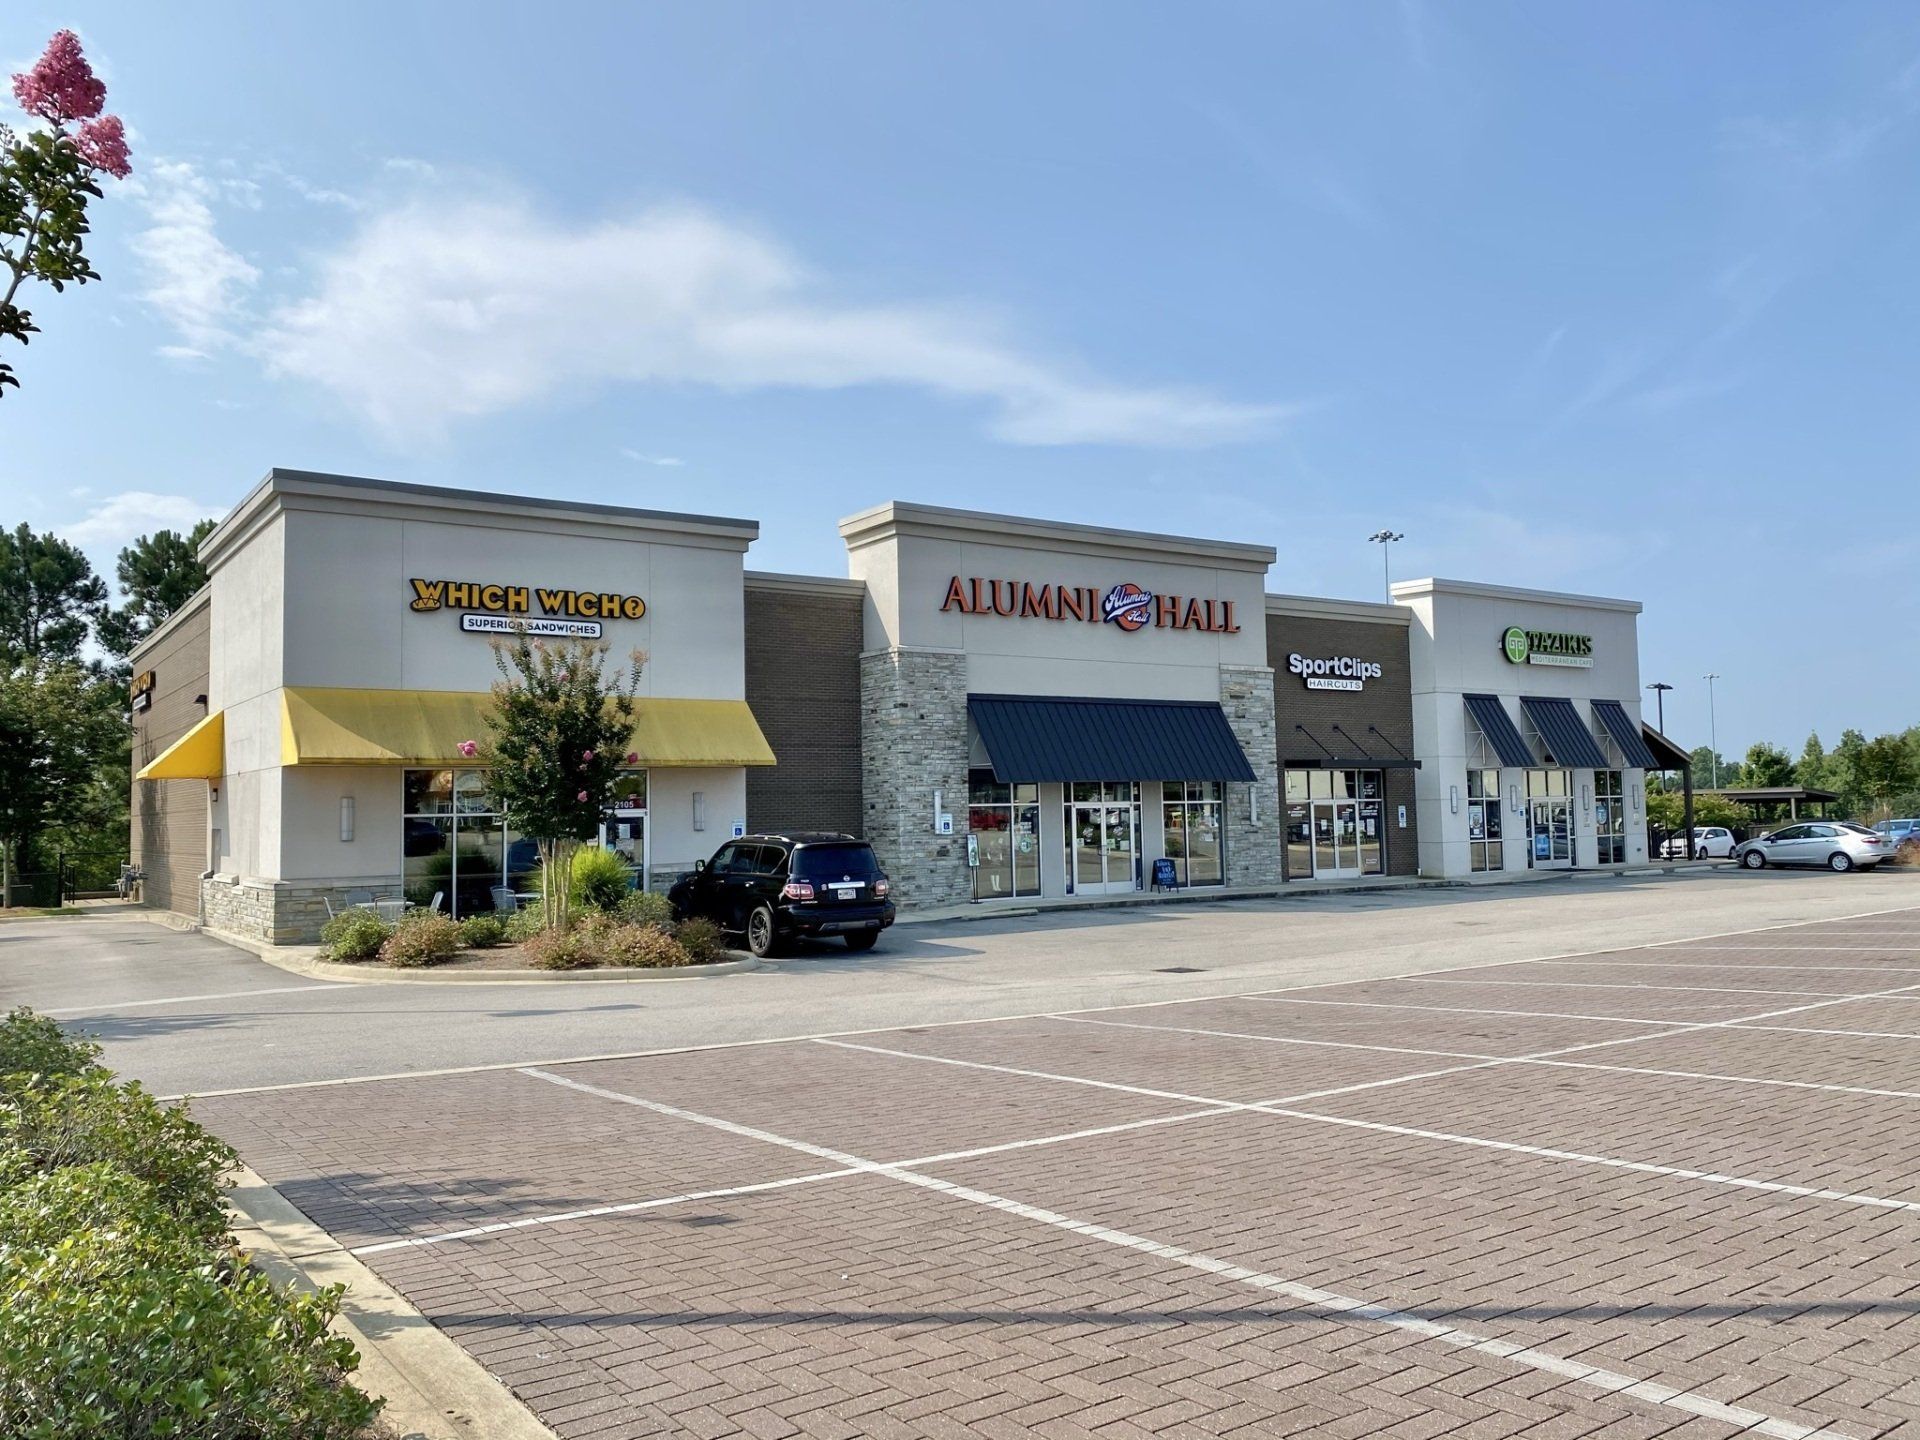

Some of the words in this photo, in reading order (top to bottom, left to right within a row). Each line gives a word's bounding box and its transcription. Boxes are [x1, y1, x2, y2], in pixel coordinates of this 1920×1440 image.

[410, 578, 529, 612] WHICH
[940, 575, 1101, 623] ALUMNI
[1154, 594, 1241, 633] HALL
[1105, 585, 1151, 611] Alumni
[1127, 610, 1150, 622] Hall
[527, 622, 596, 635] SANDWICHES
[1288, 653, 1382, 681] SportClips
[1309, 679, 1361, 689] HAIRCUTS
[614, 800, 634, 809] 2105
